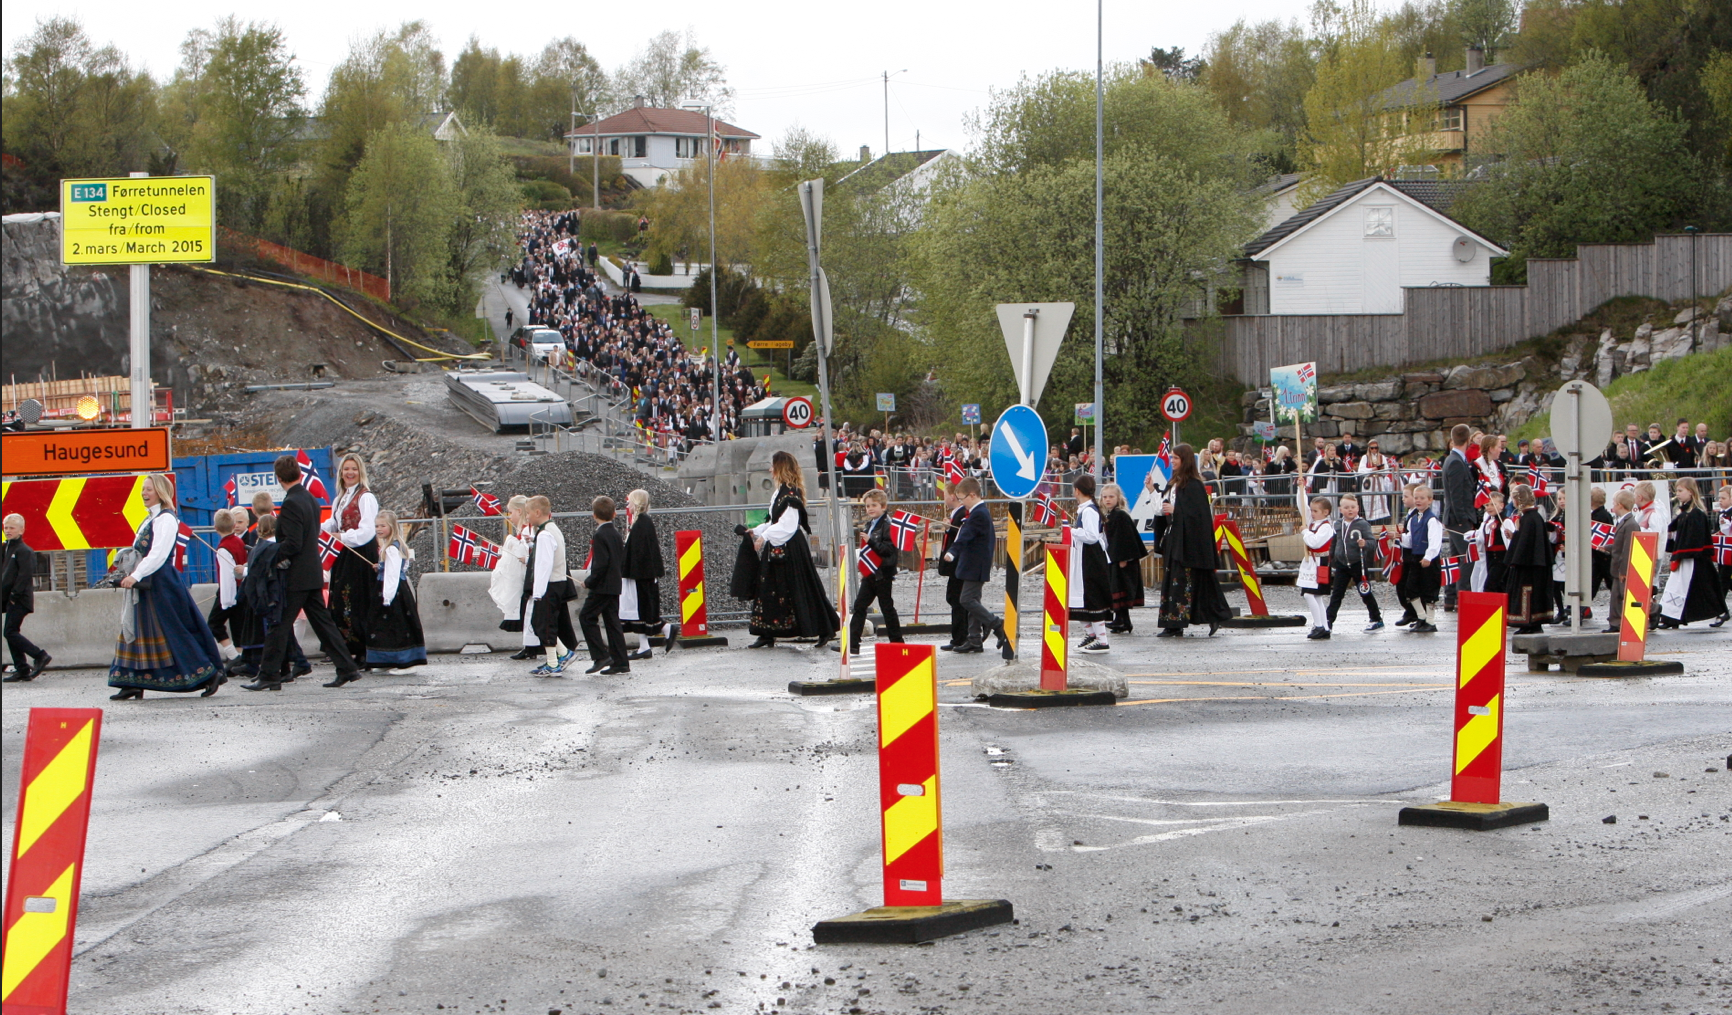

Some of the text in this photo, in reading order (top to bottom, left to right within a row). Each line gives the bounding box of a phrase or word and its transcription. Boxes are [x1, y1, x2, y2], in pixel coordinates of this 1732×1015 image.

[112, 184, 205, 198] Førretunnelen
[88, 203, 186, 219] Stengt/Closed
[109, 222, 165, 236] fra/from
[172, 240, 203, 253] 2015
[789, 404, 809, 420] 40
[1166, 398, 1187, 414] 40
[44, 440, 148, 464] Haugesund
